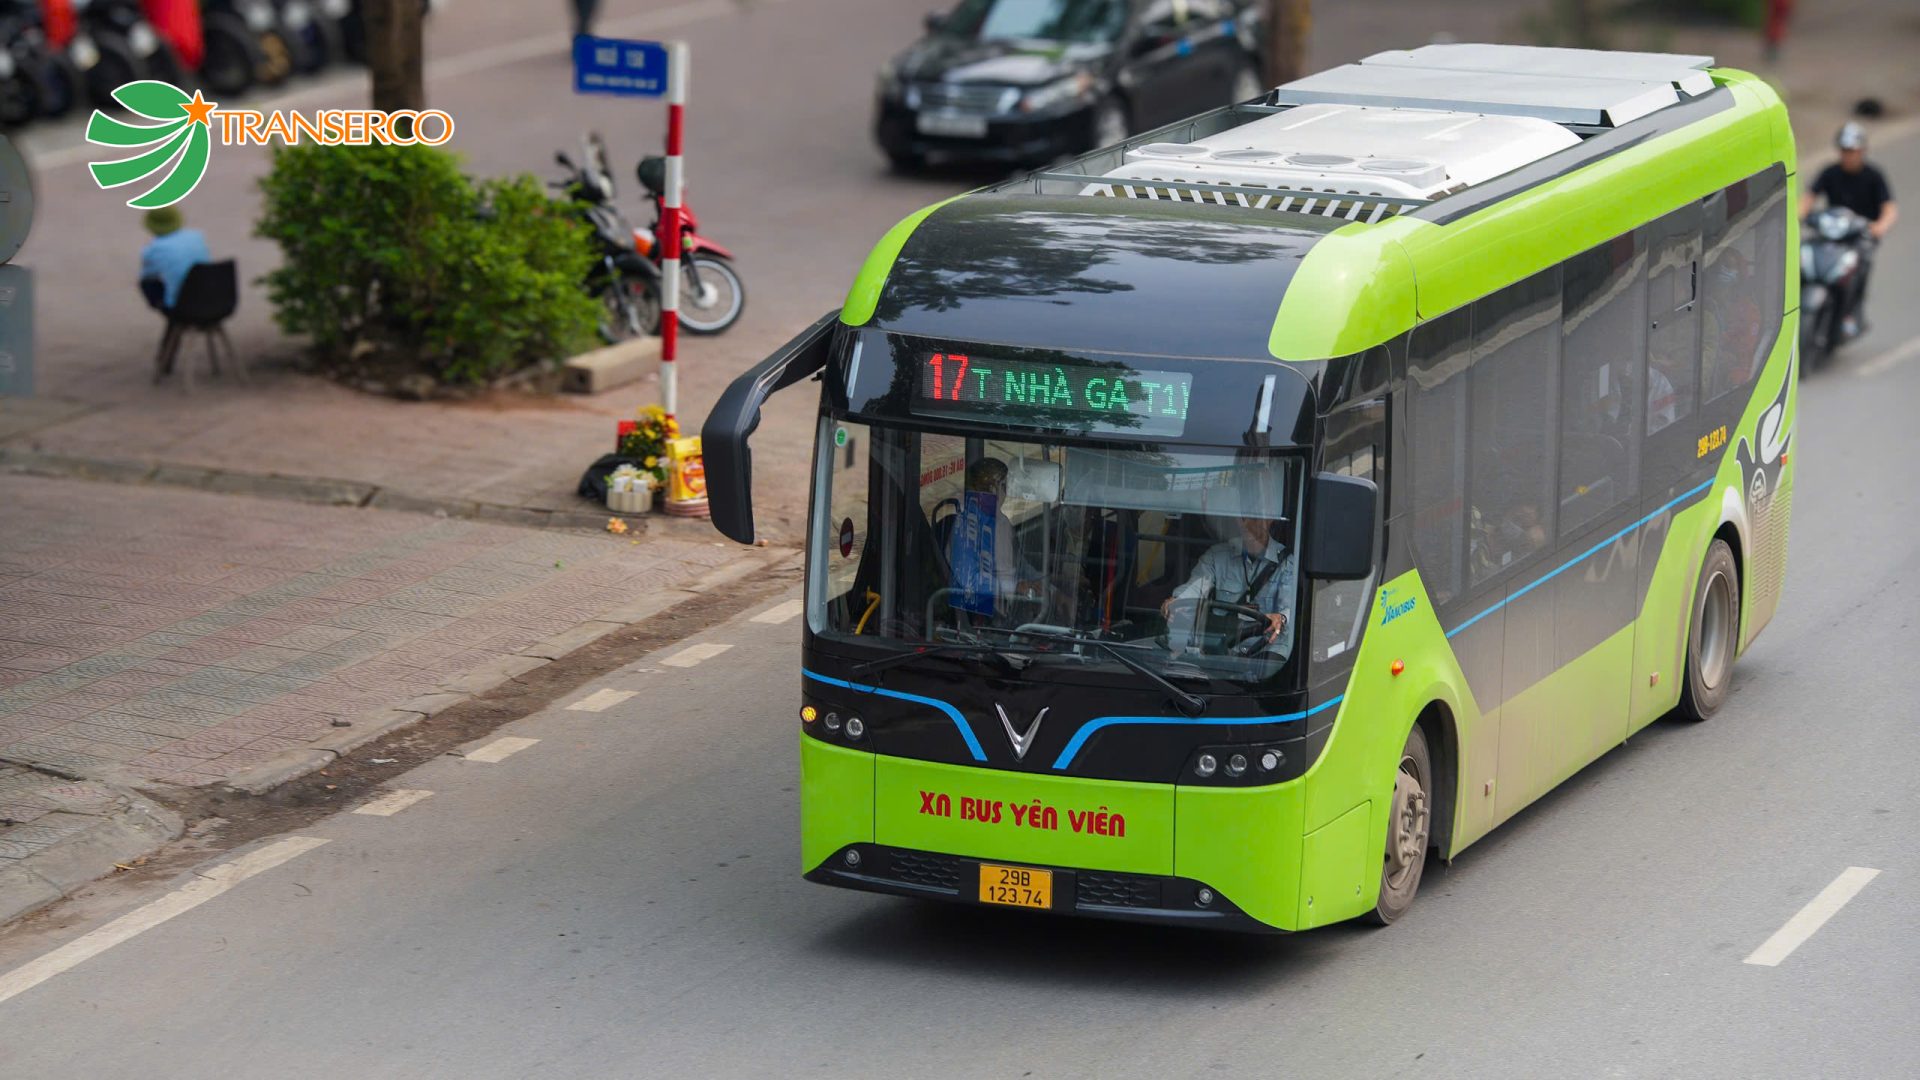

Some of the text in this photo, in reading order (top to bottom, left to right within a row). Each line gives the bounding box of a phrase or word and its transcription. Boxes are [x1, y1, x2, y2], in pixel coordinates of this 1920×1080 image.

[929, 353, 969, 400] 17
[1005, 367, 1073, 406] NHÀ
[1085, 378, 1129, 411] GA
[919, 791, 1125, 837] XN BUS YÊN VIÊN
[1000, 869, 1030, 886] 29B
[989, 886, 1042, 906] 123.74
